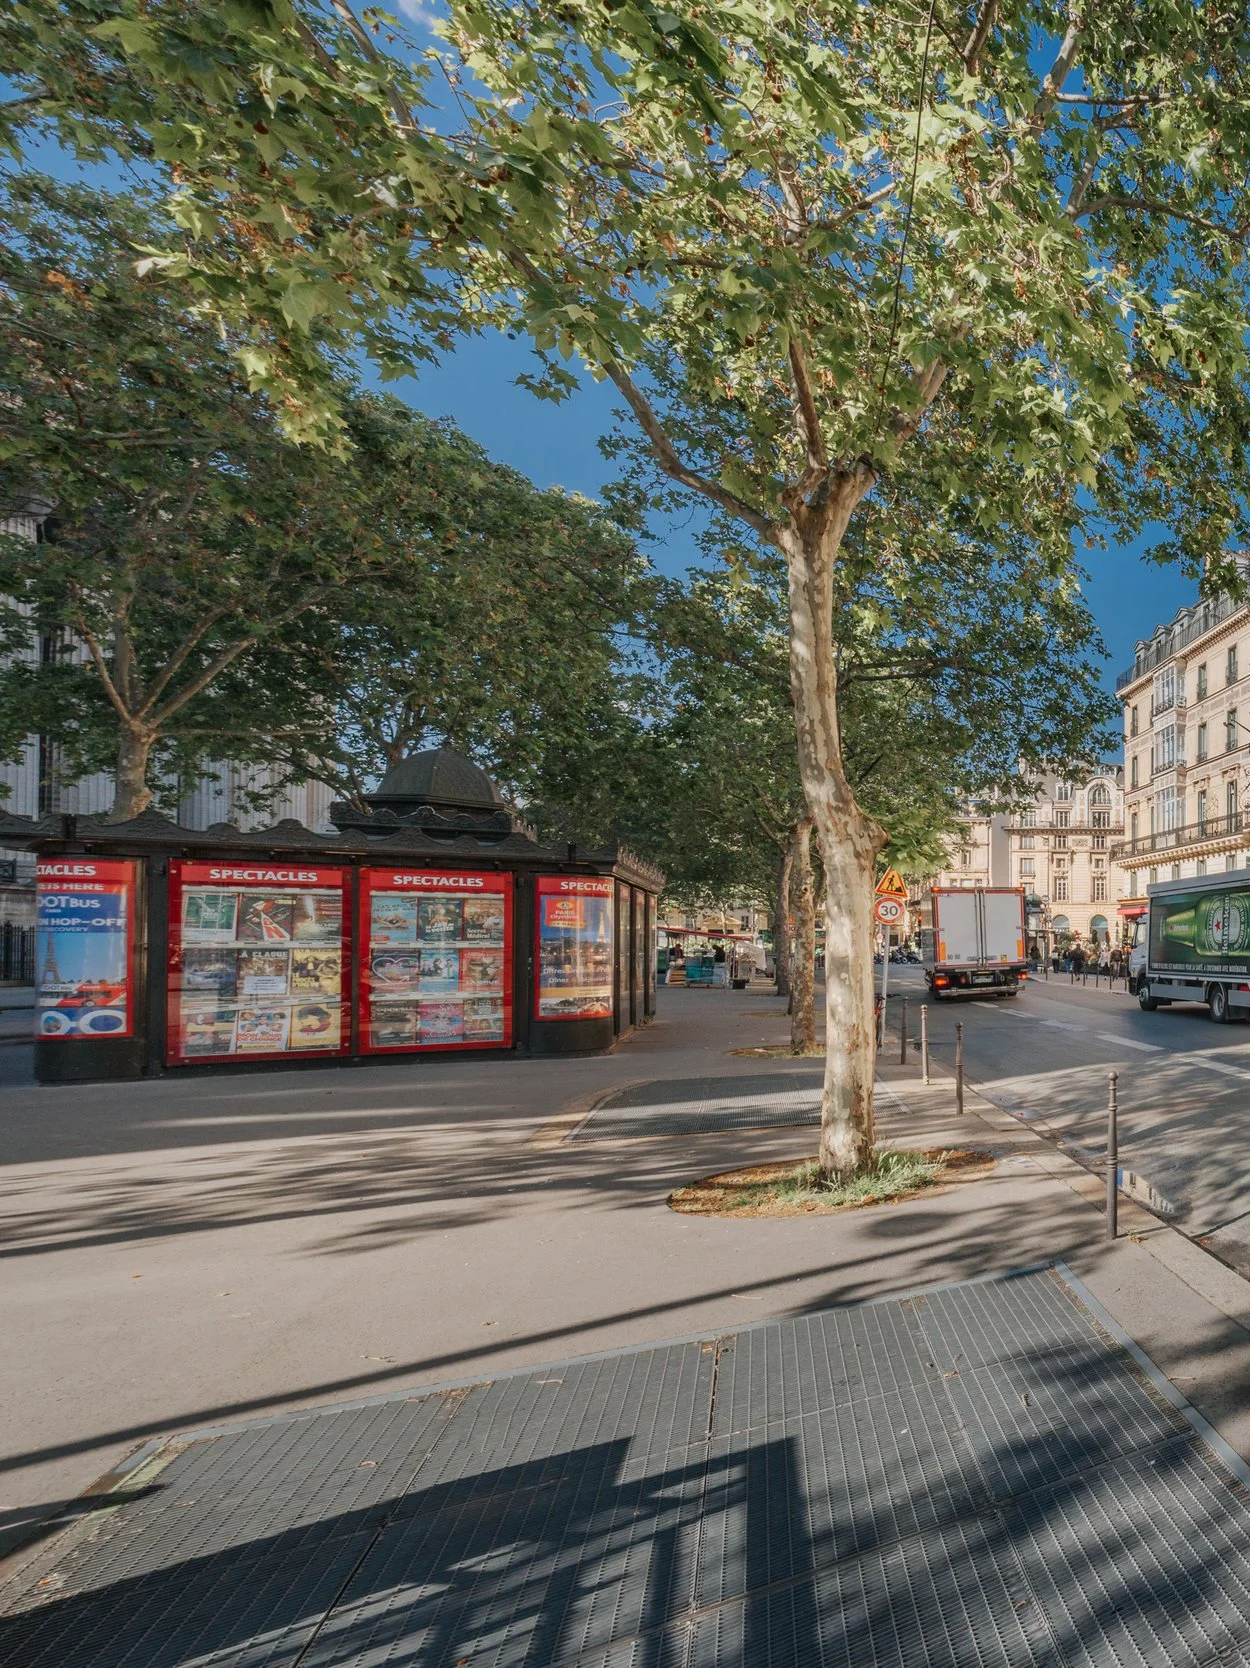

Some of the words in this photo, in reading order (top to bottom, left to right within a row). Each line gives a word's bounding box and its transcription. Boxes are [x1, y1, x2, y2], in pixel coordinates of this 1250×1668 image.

[209, 868, 318, 882] SPECTACLES
[393, 876, 484, 887] SPECTACLES
[881, 905, 898, 916] 30
[51, 918, 127, 926] HOP-OFF
[1222, 894, 1230, 954] Heineken
